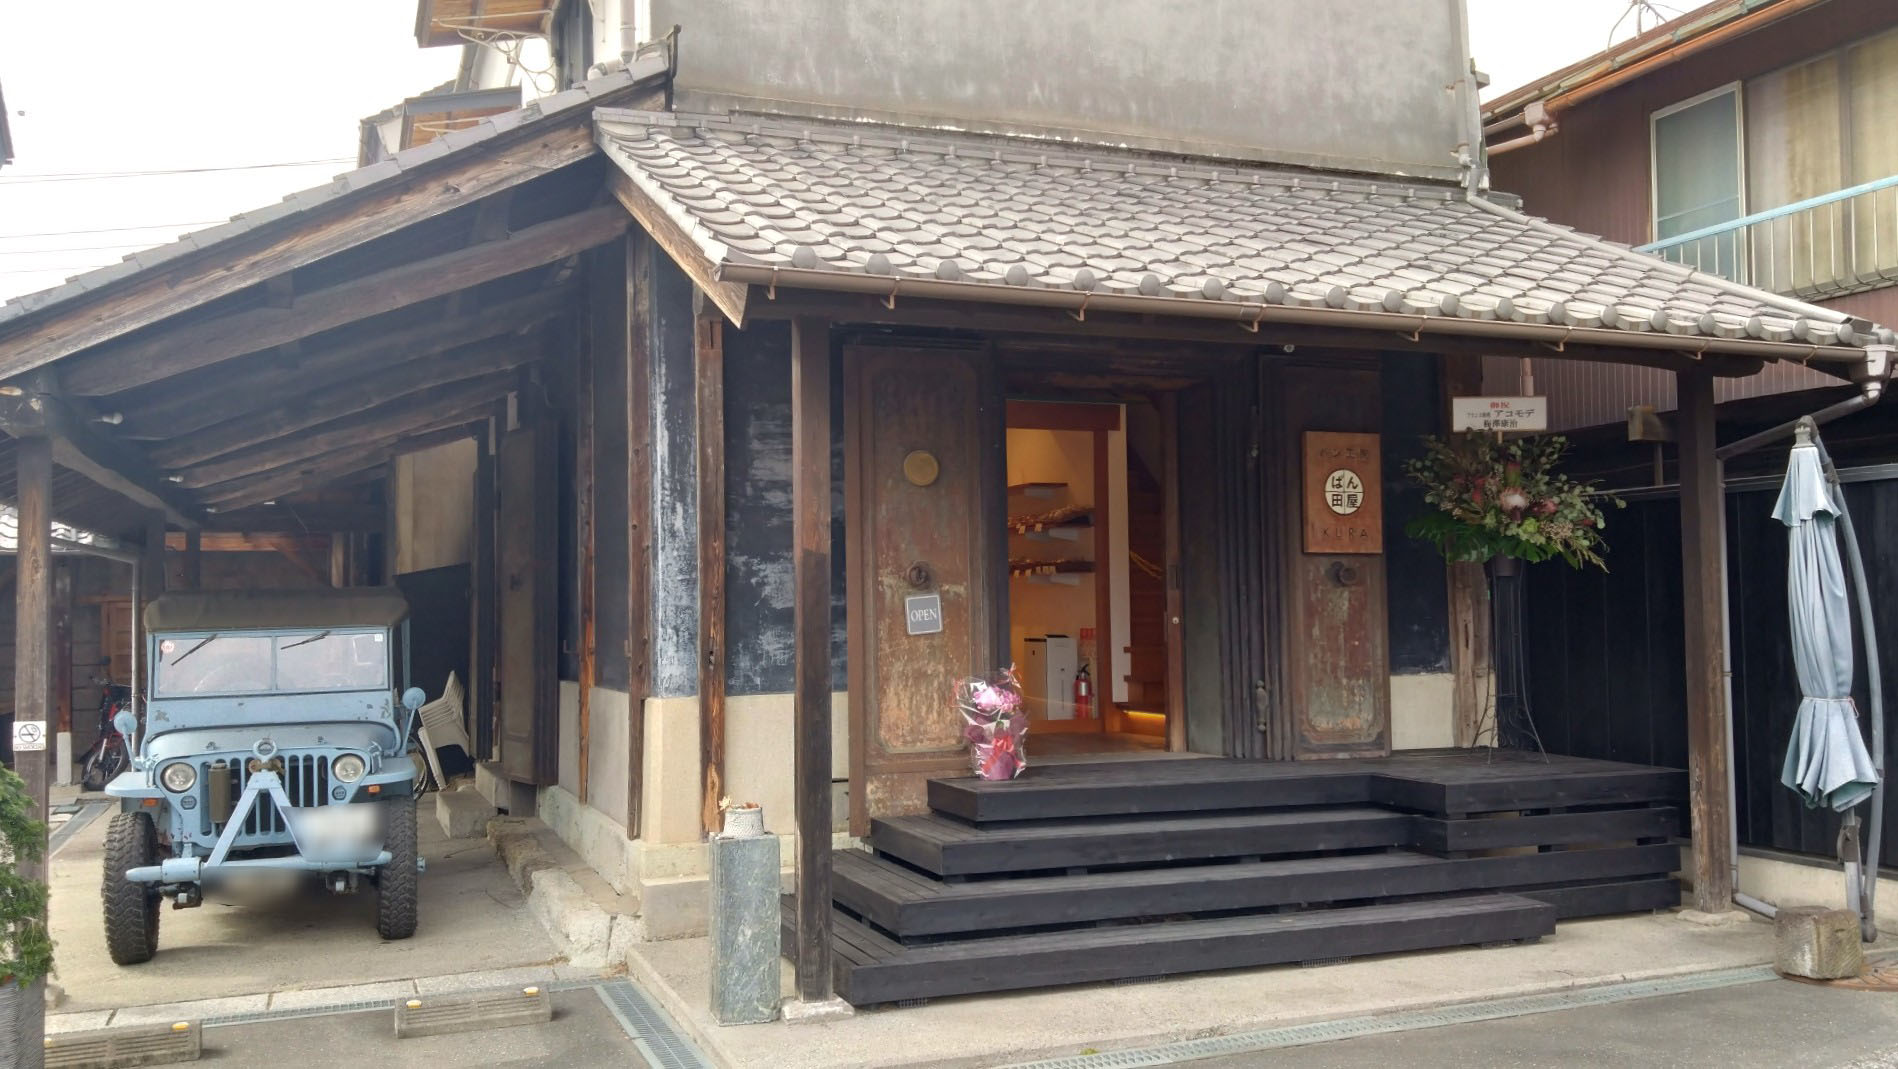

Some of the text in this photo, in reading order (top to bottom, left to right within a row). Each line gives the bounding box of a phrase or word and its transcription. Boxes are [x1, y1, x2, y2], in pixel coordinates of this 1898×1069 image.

[1494, 408, 1535, 418] アコモデ
[1332, 494, 1360, 508] 田屋
[910, 608, 937, 622] OPEN
